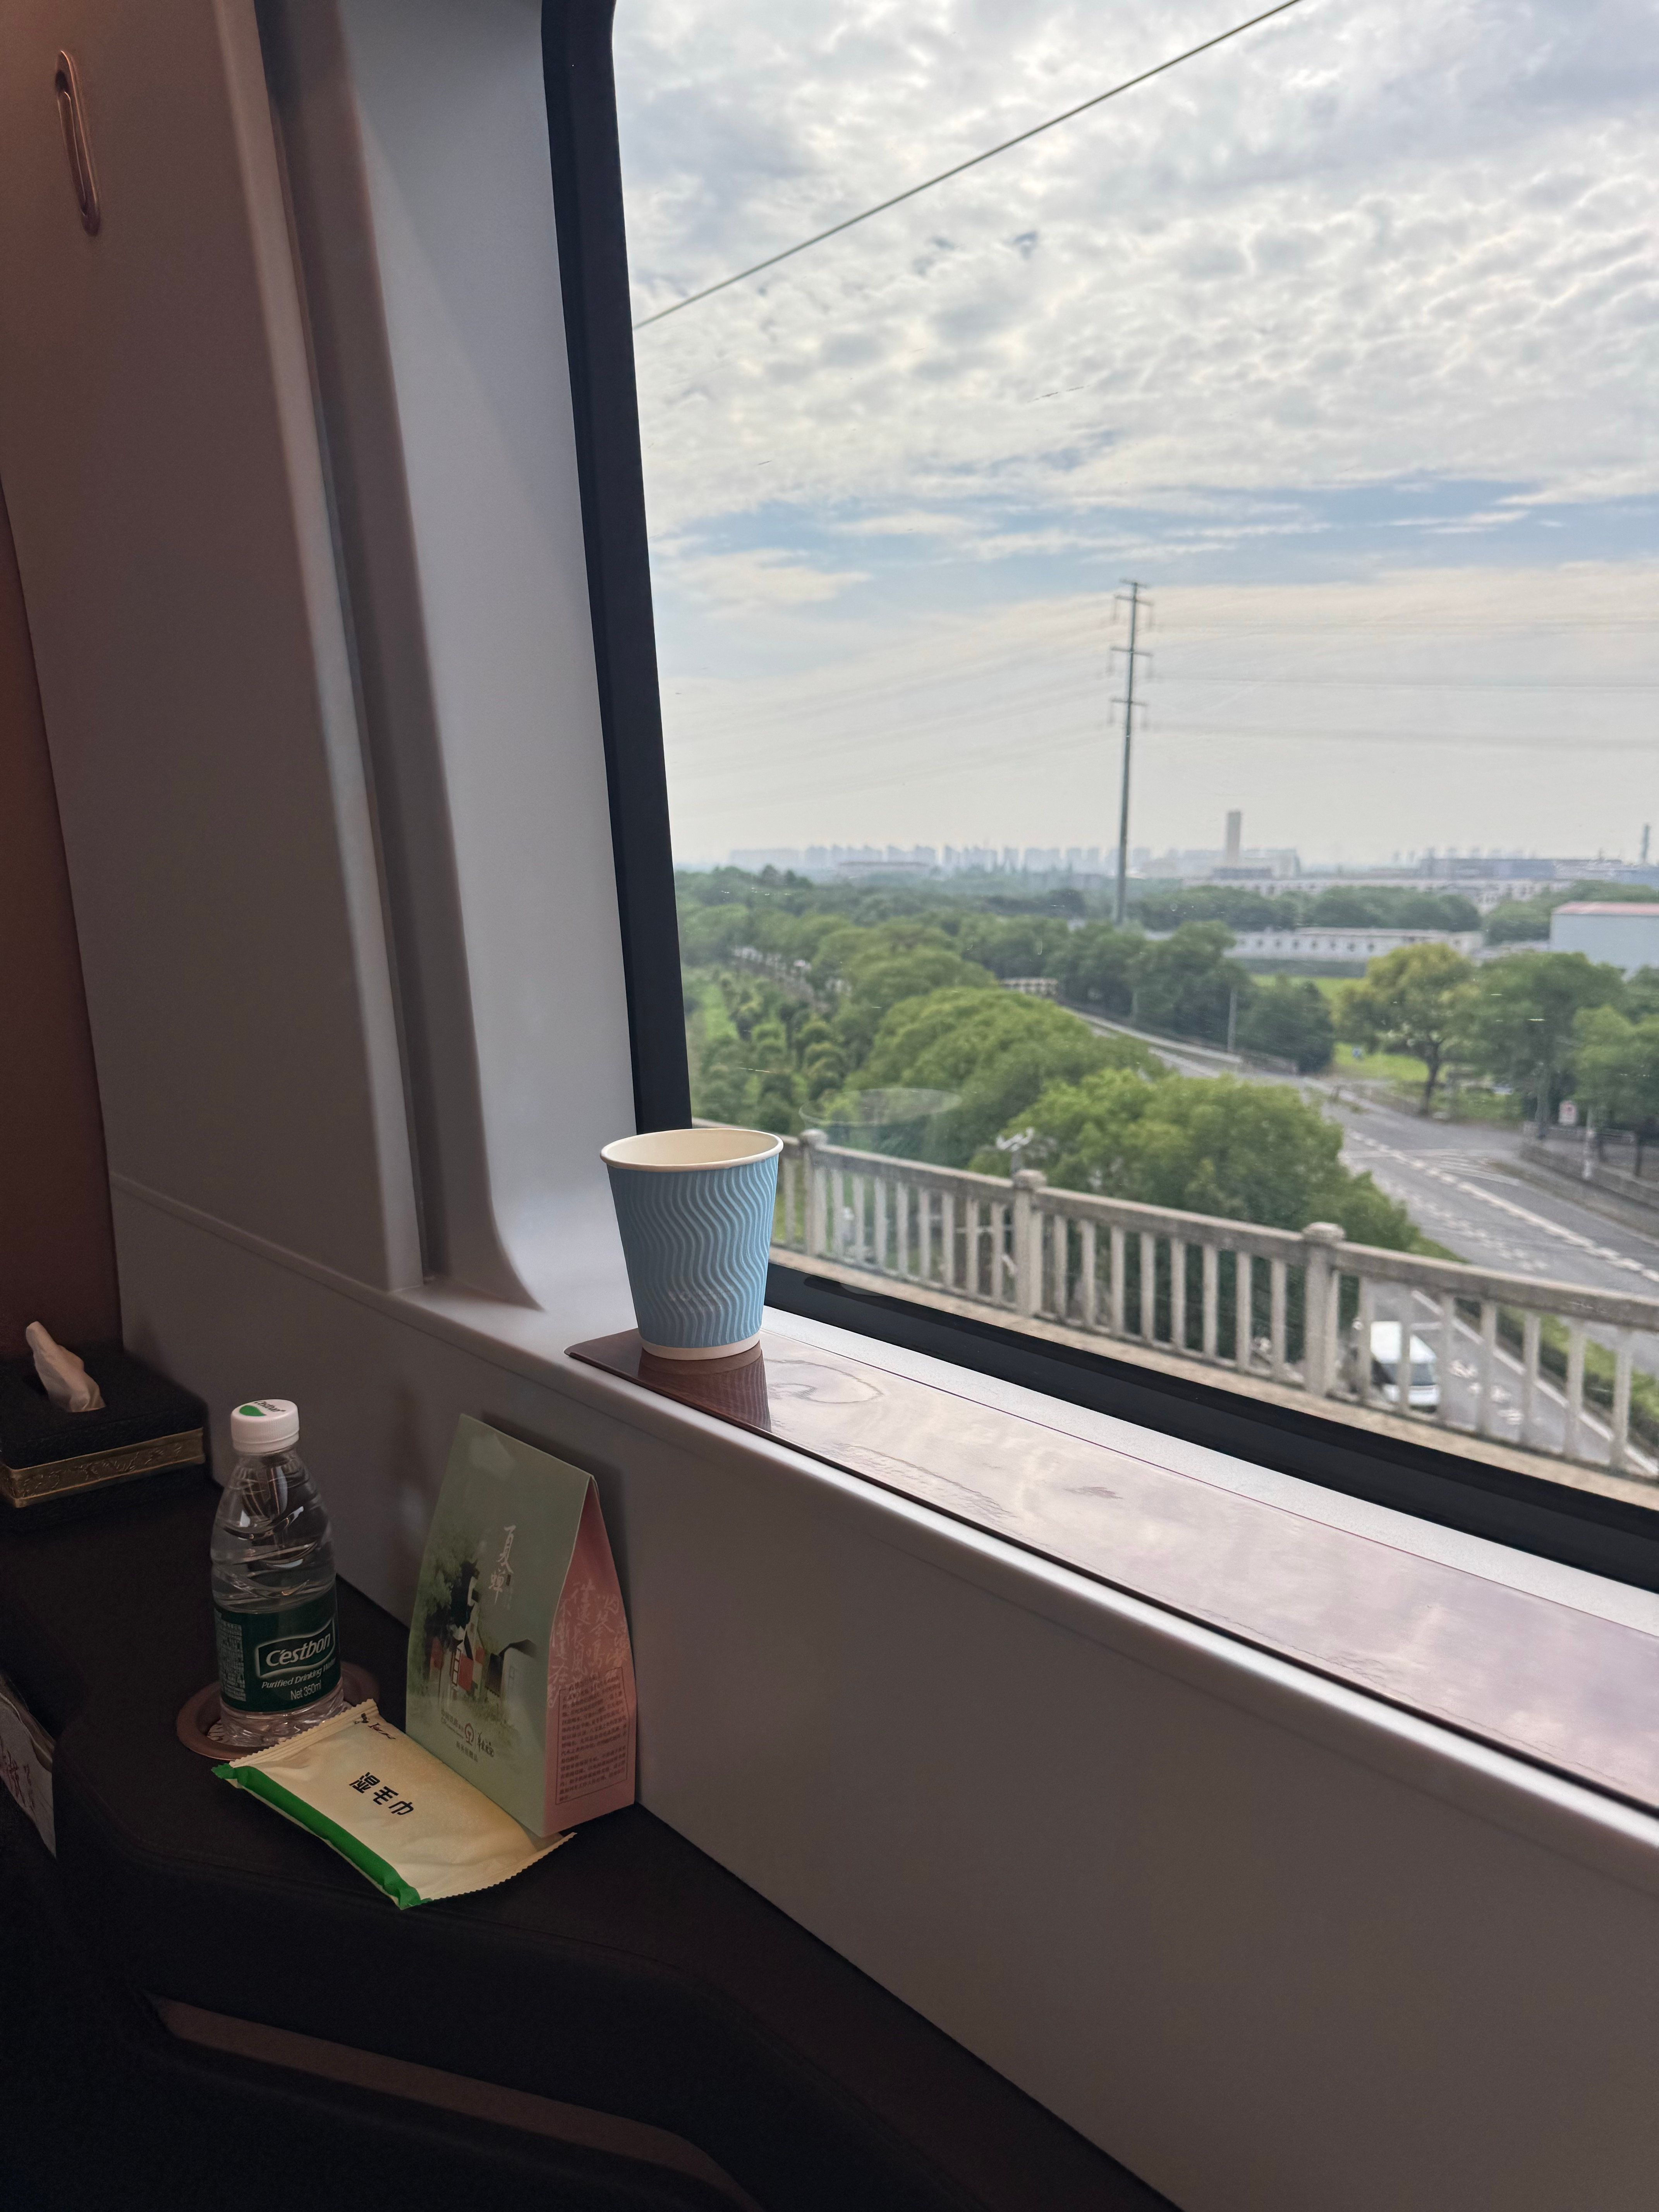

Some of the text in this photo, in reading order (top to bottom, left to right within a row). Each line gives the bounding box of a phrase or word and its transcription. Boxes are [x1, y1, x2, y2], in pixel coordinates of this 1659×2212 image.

[266, 1633, 331, 1667] C'estbon
[261, 1677, 294, 1689] Purified
[295, 1668, 322, 1684] Drinking
[290, 1680, 322, 1700] Net 350ml
[349, 1771, 414, 1816] 湿毛巾
